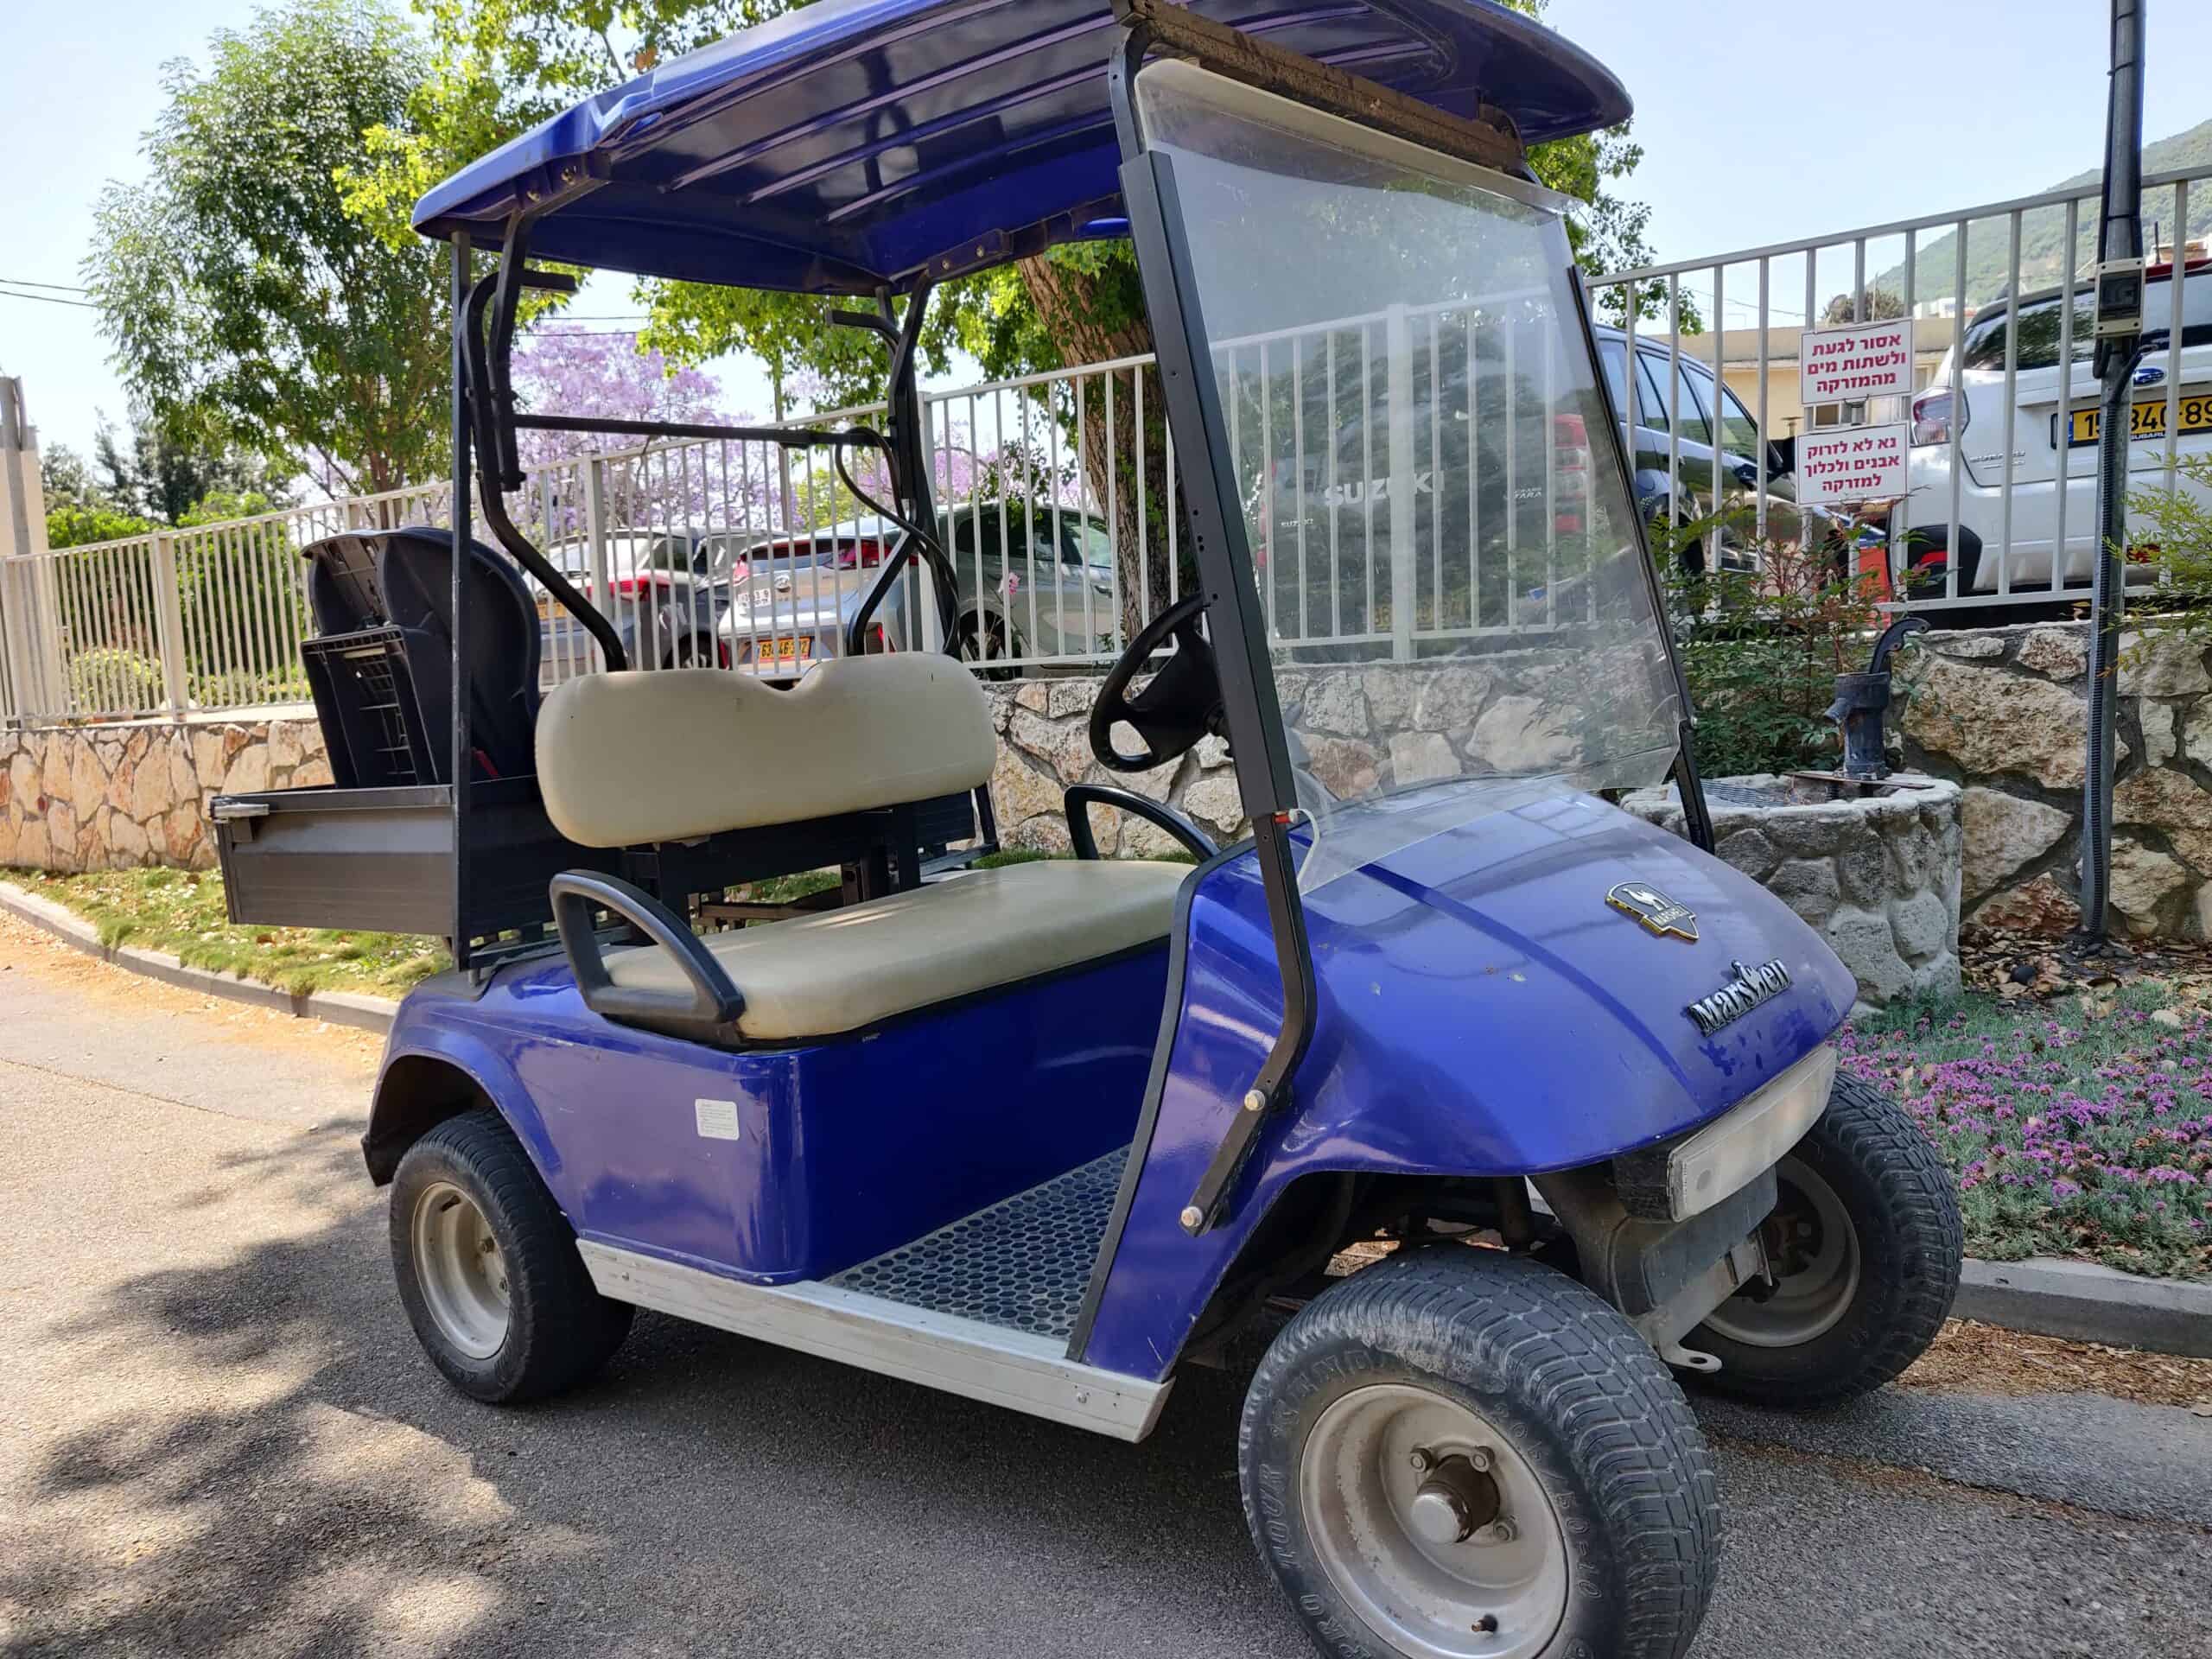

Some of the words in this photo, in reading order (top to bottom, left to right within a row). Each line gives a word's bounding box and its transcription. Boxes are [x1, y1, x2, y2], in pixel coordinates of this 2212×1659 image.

[1812, 338, 1855, 357] לגעת
[1859, 334, 1902, 350] אסור
[1808, 361, 1838, 375] מים
[1841, 351, 1906, 372] ולשתות
[1816, 372, 1897, 394] מהמזרקה
[1807, 440, 1848, 460] לזרוק
[1853, 437, 1874, 452] לא
[1878, 437, 1897, 449] נא
[1803, 459, 1849, 478] ולכלוך
[1853, 455, 1900, 470] אבנים
[1324, 470, 1446, 506] SUZKI
[1822, 473, 1882, 493] למזרקה
